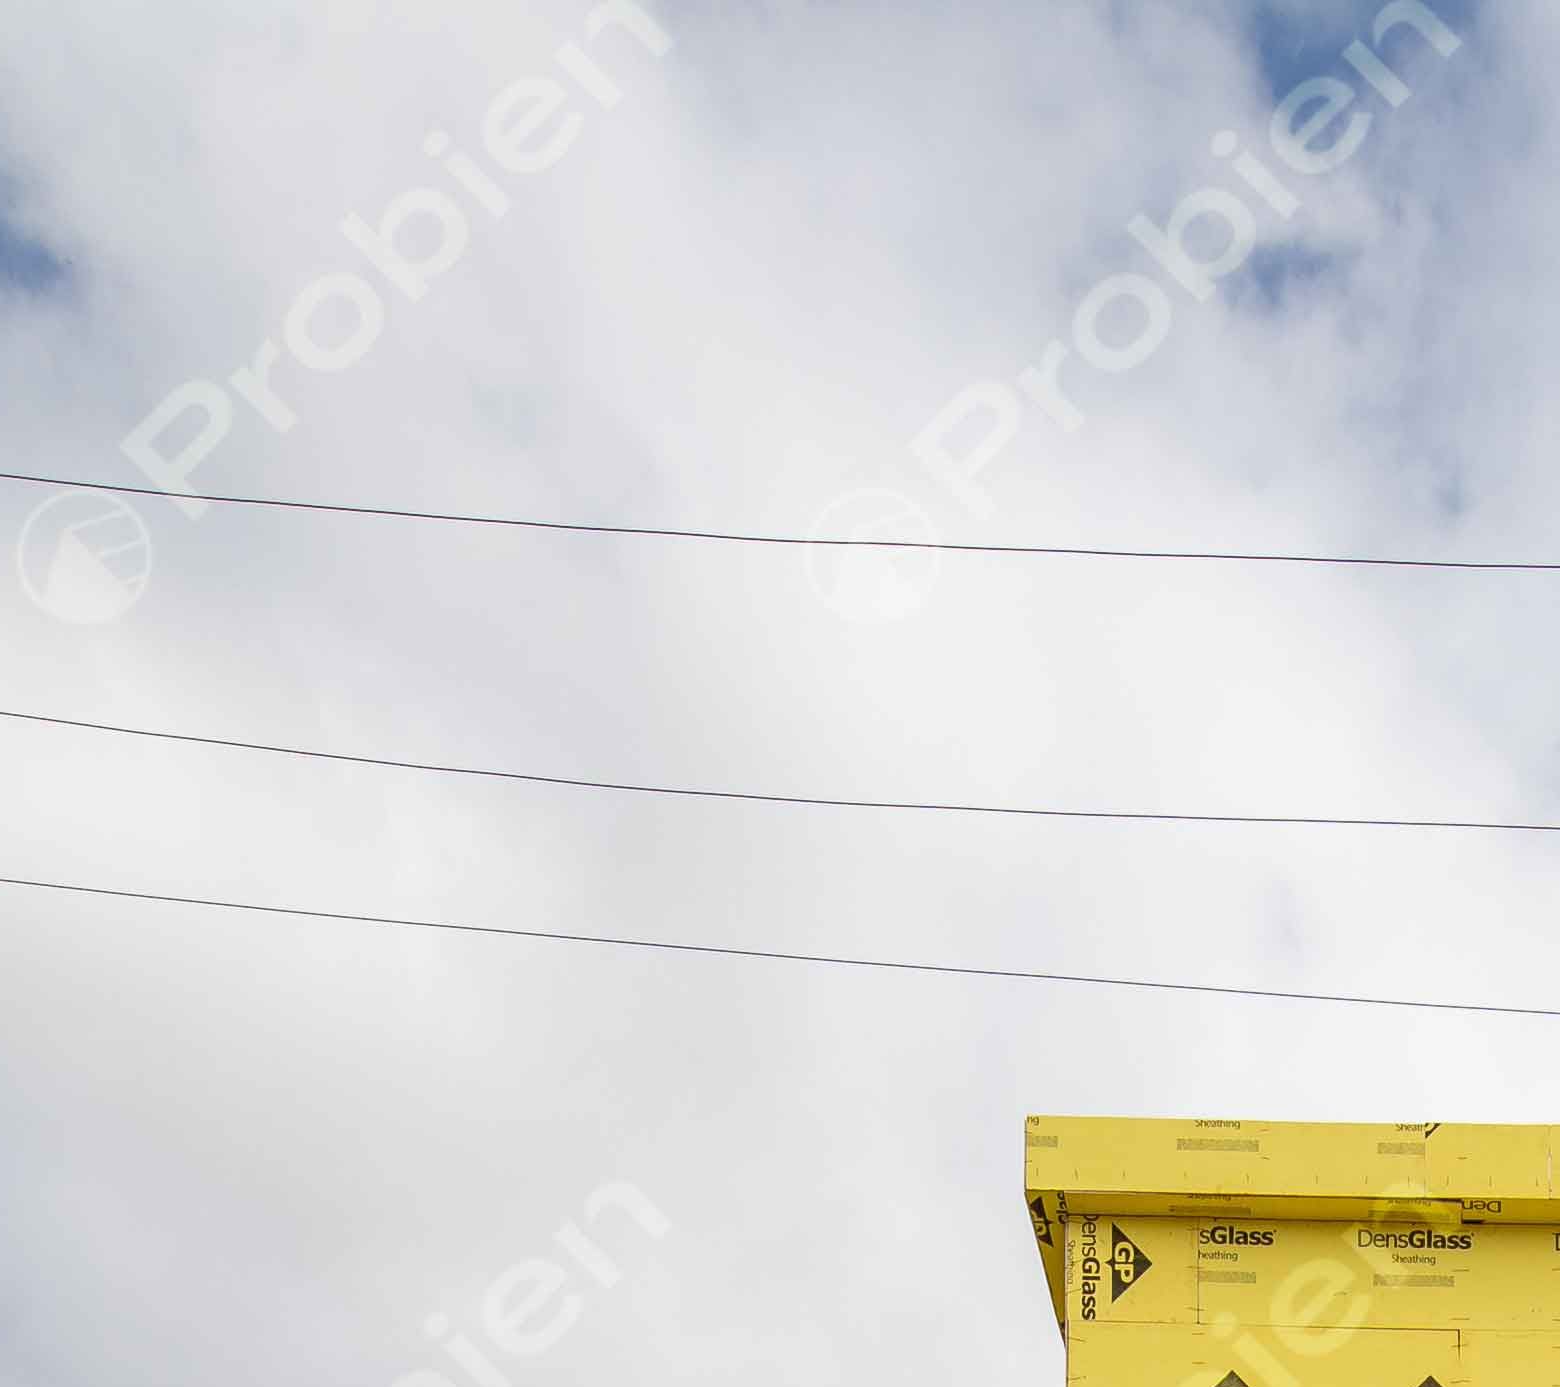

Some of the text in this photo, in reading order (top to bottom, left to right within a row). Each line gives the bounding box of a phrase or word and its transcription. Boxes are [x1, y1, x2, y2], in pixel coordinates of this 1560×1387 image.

[1198, 1226, 1274, 1247] sGlass
[1357, 1228, 1472, 1251] DensGlass
[1114, 1241, 1134, 1284] GP
[1198, 1250, 1239, 1263] heathing
[1391, 1253, 1436, 1266] Sheathing
